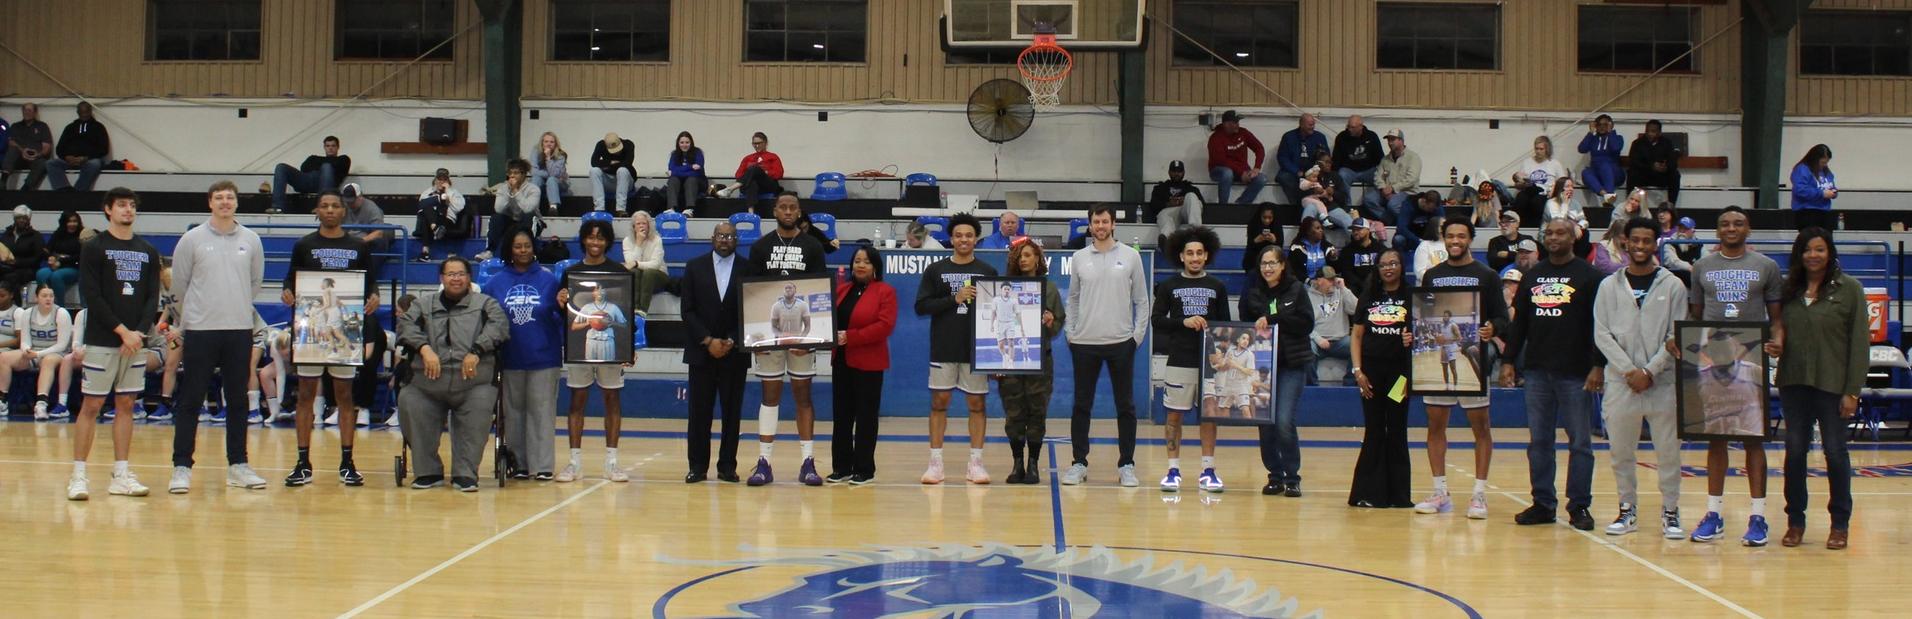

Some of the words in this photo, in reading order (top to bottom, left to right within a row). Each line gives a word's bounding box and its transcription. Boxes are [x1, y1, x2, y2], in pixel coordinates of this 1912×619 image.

[311, 248, 358, 260] TOUGHER
[772, 246, 786, 254] PLAY
[105, 249, 149, 263] TOUGHER
[770, 253, 784, 261] PLAY
[115, 259, 142, 271] TEAM
[766, 260, 780, 270] PLAY
[115, 269, 141, 281] WINS
[1706, 269, 1760, 282] TOUGHER
[1432, 276, 1479, 287] TOUGHER
[1715, 280, 1749, 291] TEAM
[1172, 287, 1217, 299] TOUGHER
[1717, 291, 1748, 302] WINS
[1181, 296, 1209, 306] TEAM
[1182, 305, 1208, 316] WINS
[1536, 307, 1562, 317] DAD
[1371, 326, 1401, 335] MOM
